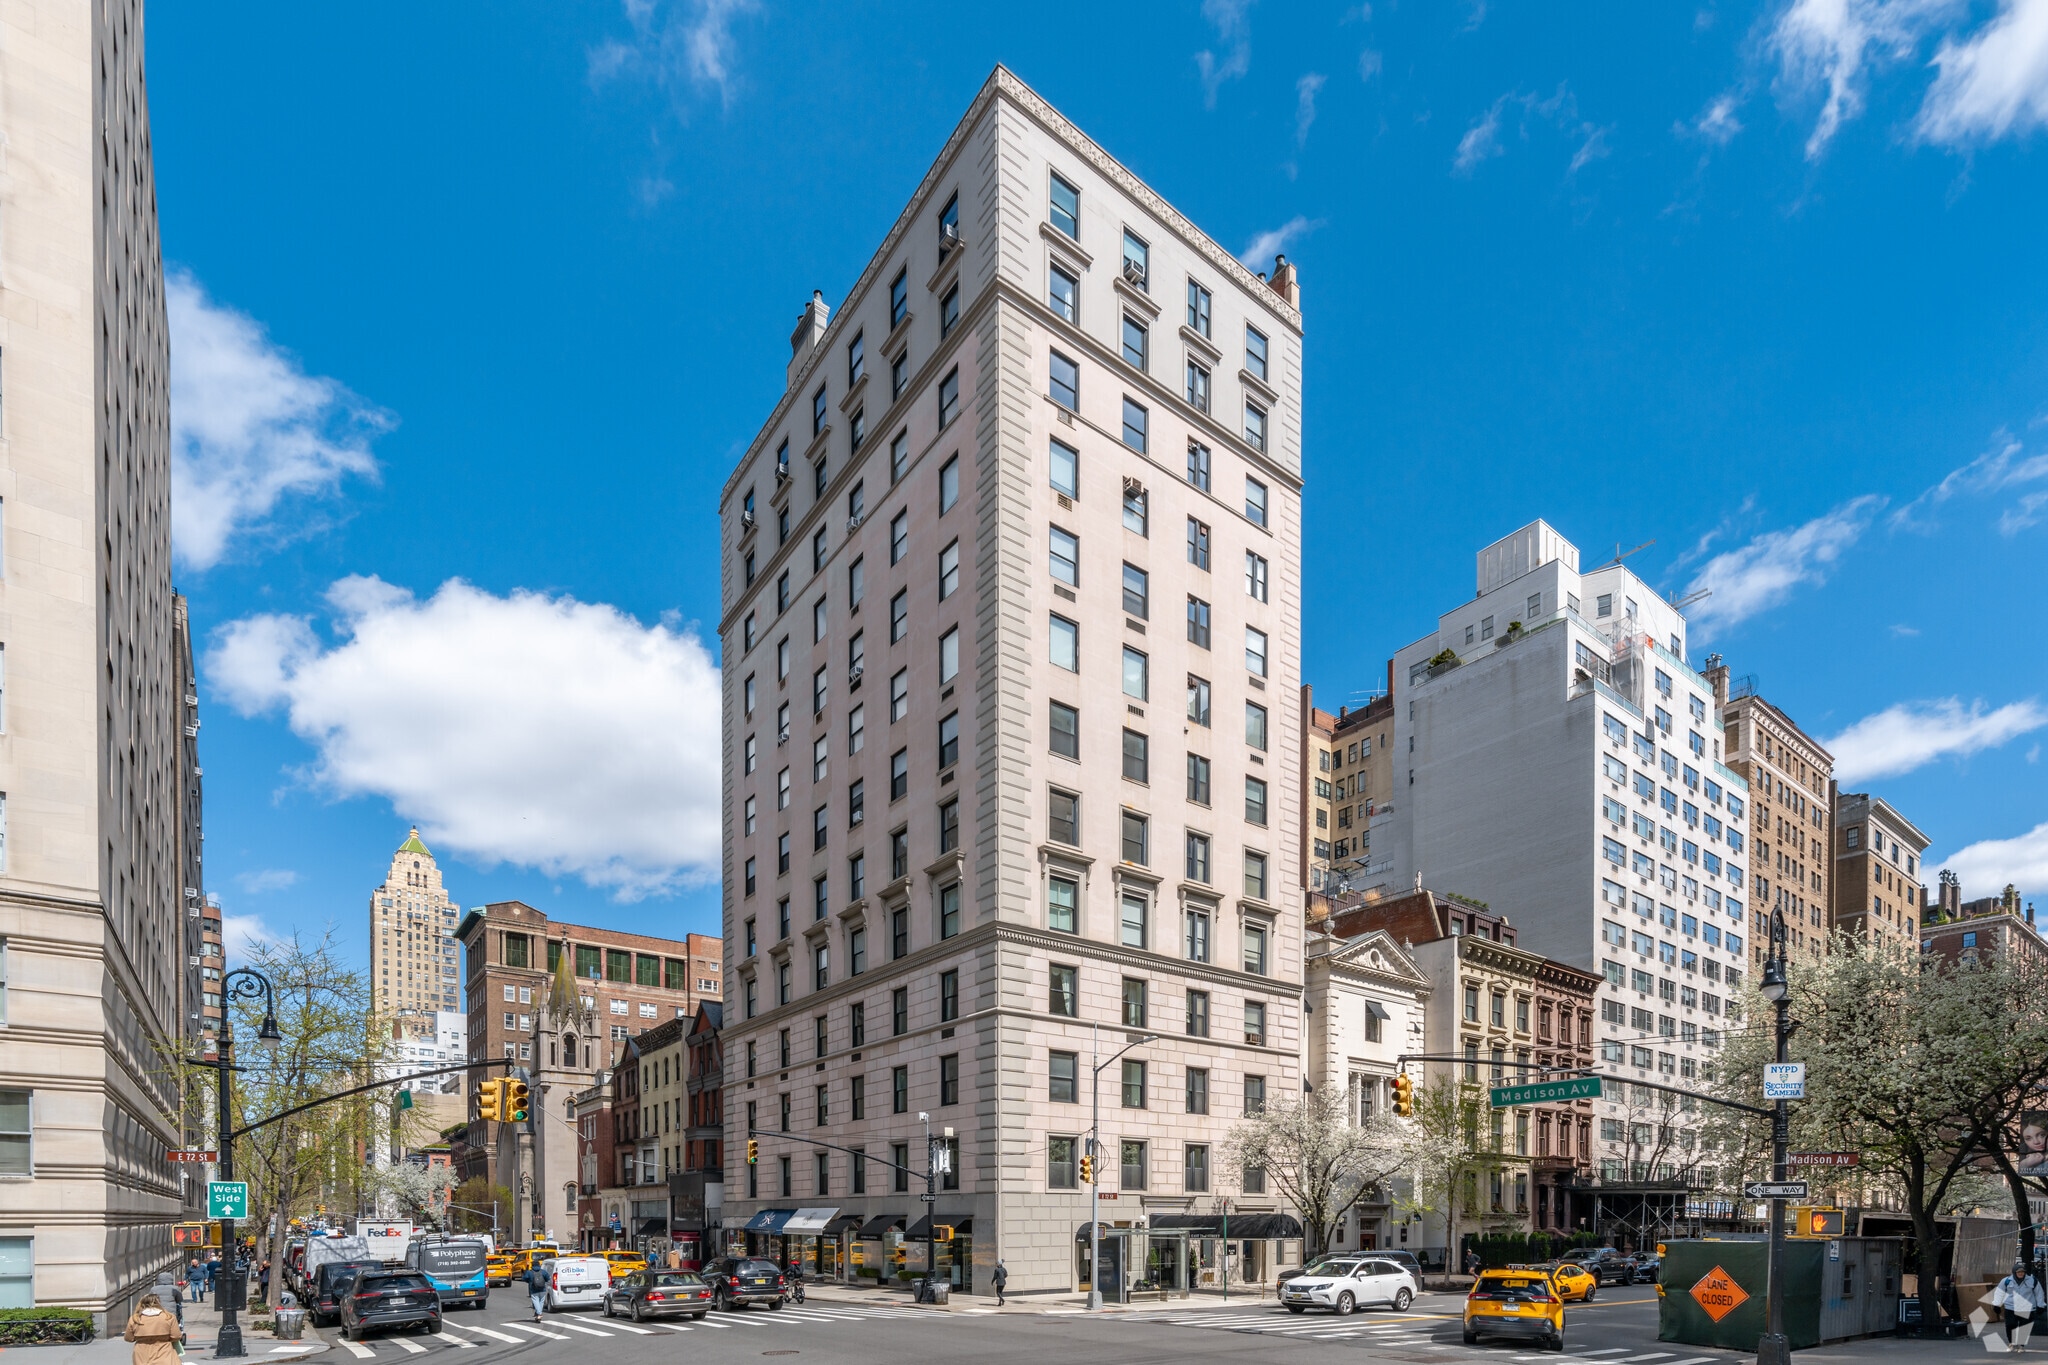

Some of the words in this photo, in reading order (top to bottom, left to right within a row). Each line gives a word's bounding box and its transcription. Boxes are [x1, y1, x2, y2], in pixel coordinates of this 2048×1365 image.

[1501, 1087, 1566, 1102] Madison
[1570, 1084, 1590, 1095] Av
[1790, 1155, 1832, 1164] Madison
[1836, 1155, 1850, 1164] Av
[213, 1185, 242, 1193] West
[215, 1194, 241, 1202] Side
[367, 1228, 402, 1237] FedEx
[440, 1250, 476, 1258] Polyphase
[1707, 1280, 1728, 1290] LANE
[1701, 1293, 1733, 1306] CLOSED
